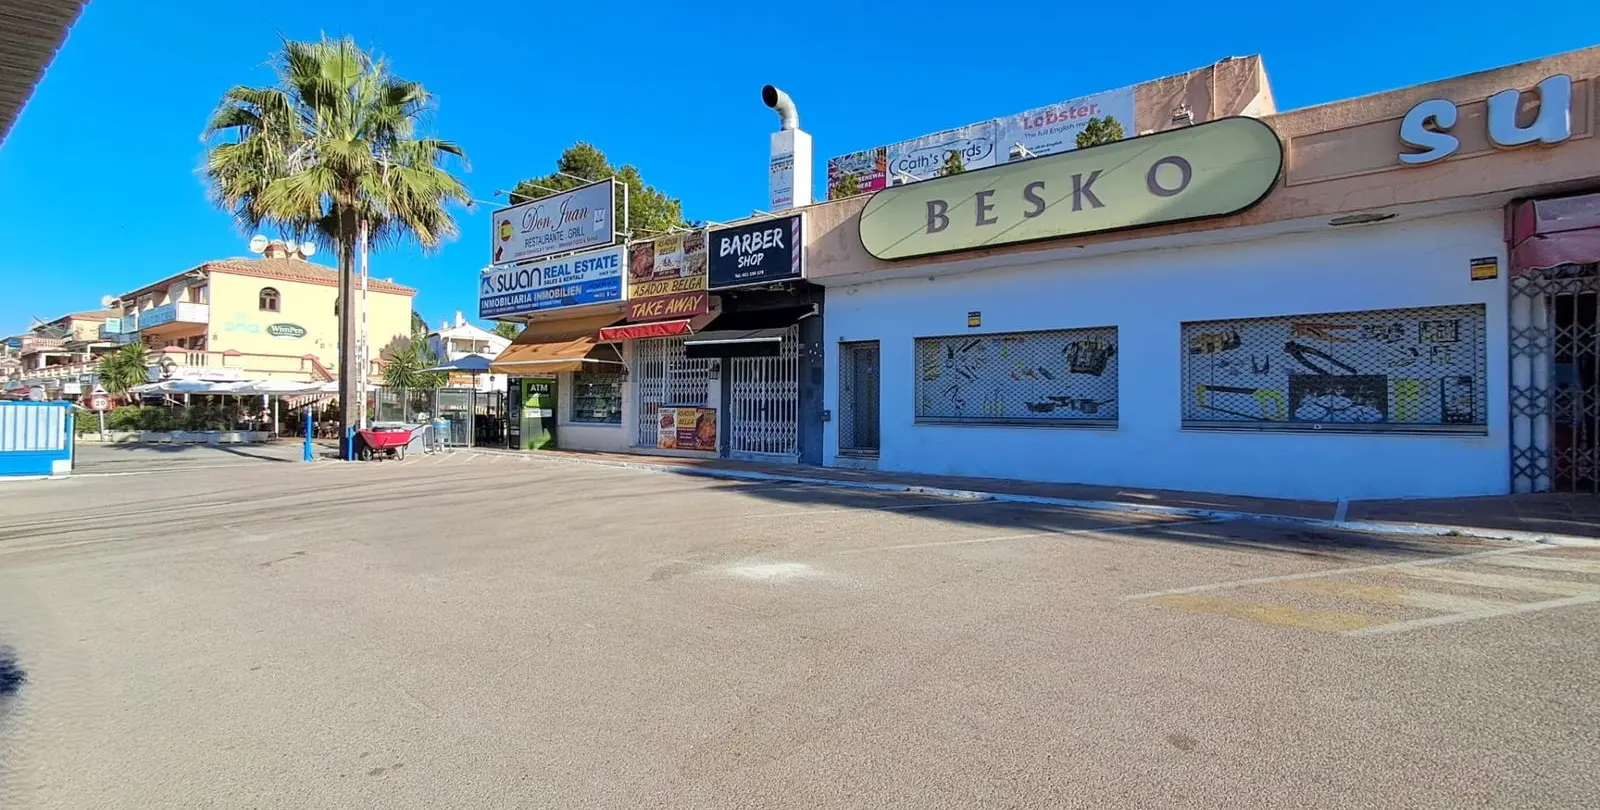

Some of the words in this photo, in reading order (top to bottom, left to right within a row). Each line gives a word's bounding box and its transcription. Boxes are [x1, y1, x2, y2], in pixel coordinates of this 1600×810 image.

[1050, 123, 1076, 134] English
[898, 154, 938, 170] Cath's
[942, 144, 982, 164] Crds
[926, 155, 1192, 234] BESKO
[521, 204, 550, 234] Don
[551, 195, 589, 231] Juan
[524, 230, 564, 249] RESTAURANTE
[568, 226, 585, 239] GRILL
[720, 228, 784, 257] BARBER
[544, 264, 570, 279] REAL
[574, 254, 618, 274] ESTATE
[738, 253, 764, 268] SHOP
[481, 293, 532, 309] INMOBILIARIA
[534, 285, 582, 302] INMOBILIEN
[633, 281, 669, 296] ASADOR
[671, 277, 702, 292] BELGA
[632, 299, 663, 318] TAKE
[665, 294, 704, 314] AWAY
[530, 384, 548, 392] ATM
